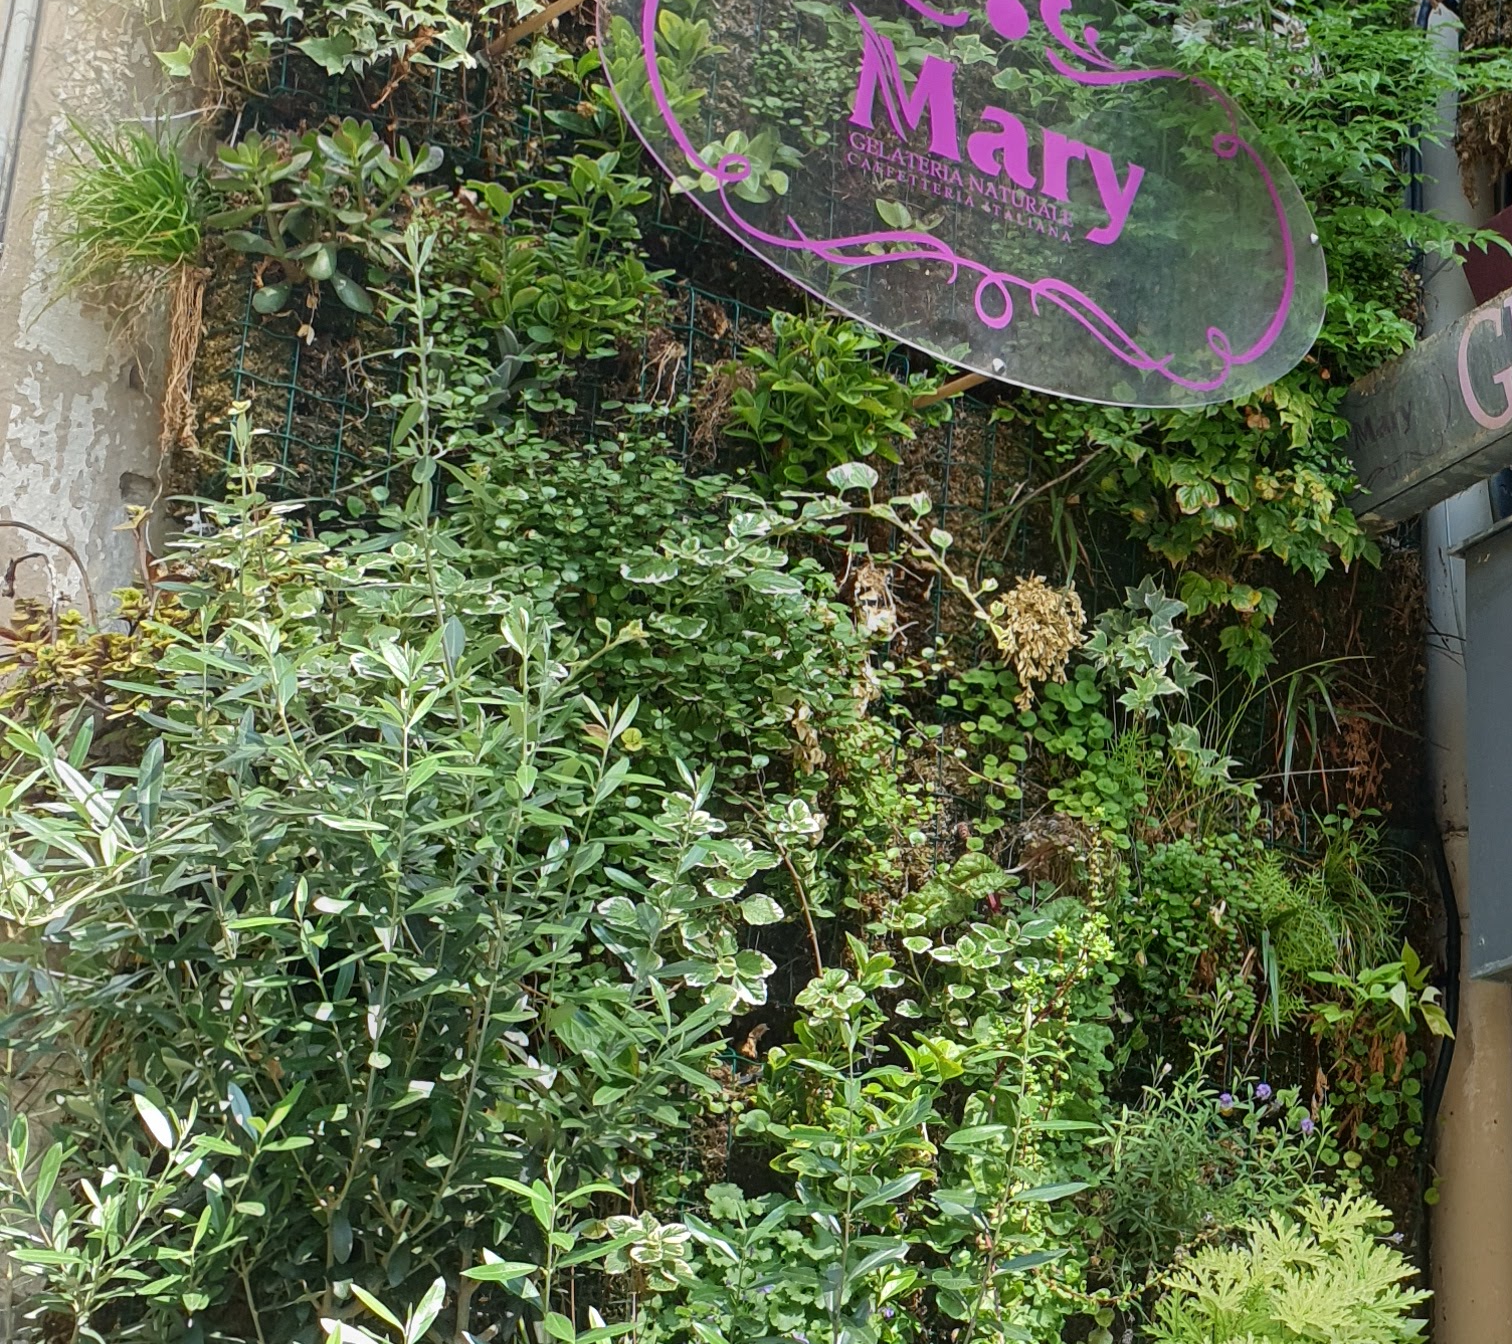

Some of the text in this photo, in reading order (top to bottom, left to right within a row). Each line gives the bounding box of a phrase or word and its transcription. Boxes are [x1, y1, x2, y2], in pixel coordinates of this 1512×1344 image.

[846, 3, 1145, 245] Mary
[847, 152, 975, 208] CAFFETTERIA
[849, 131, 1074, 228] GELATERIA NATURALE
